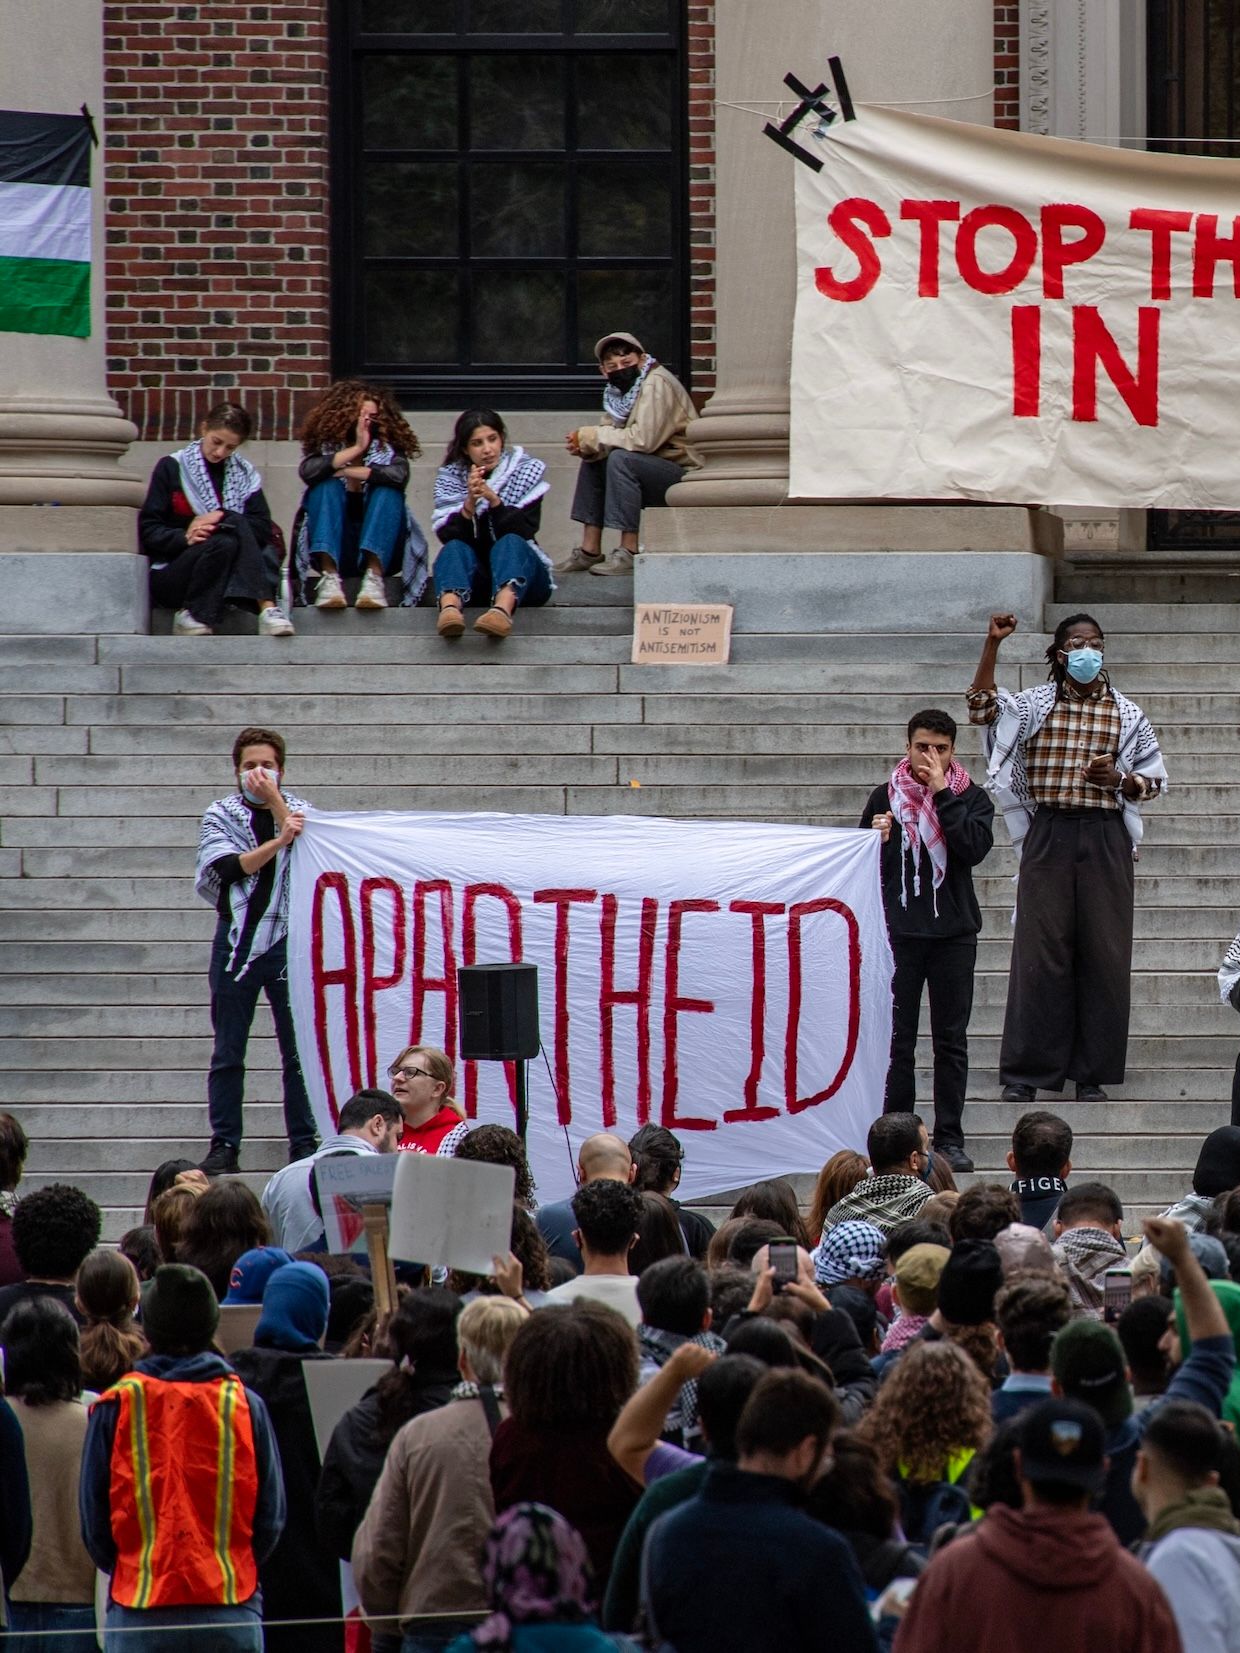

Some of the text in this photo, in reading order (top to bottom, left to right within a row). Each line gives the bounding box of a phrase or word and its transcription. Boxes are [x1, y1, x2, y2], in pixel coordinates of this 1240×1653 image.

[814, 198, 1106, 302] STOP
[1010, 303, 1161, 429] IN
[641, 610, 720, 625] ANTIZIONISM
[658, 627, 701, 636] IS NOT
[640, 641, 716, 654] ANTISEMITISM
[311, 871, 862, 1134] APARTHEID
[320, 1161, 355, 1181] FREE
